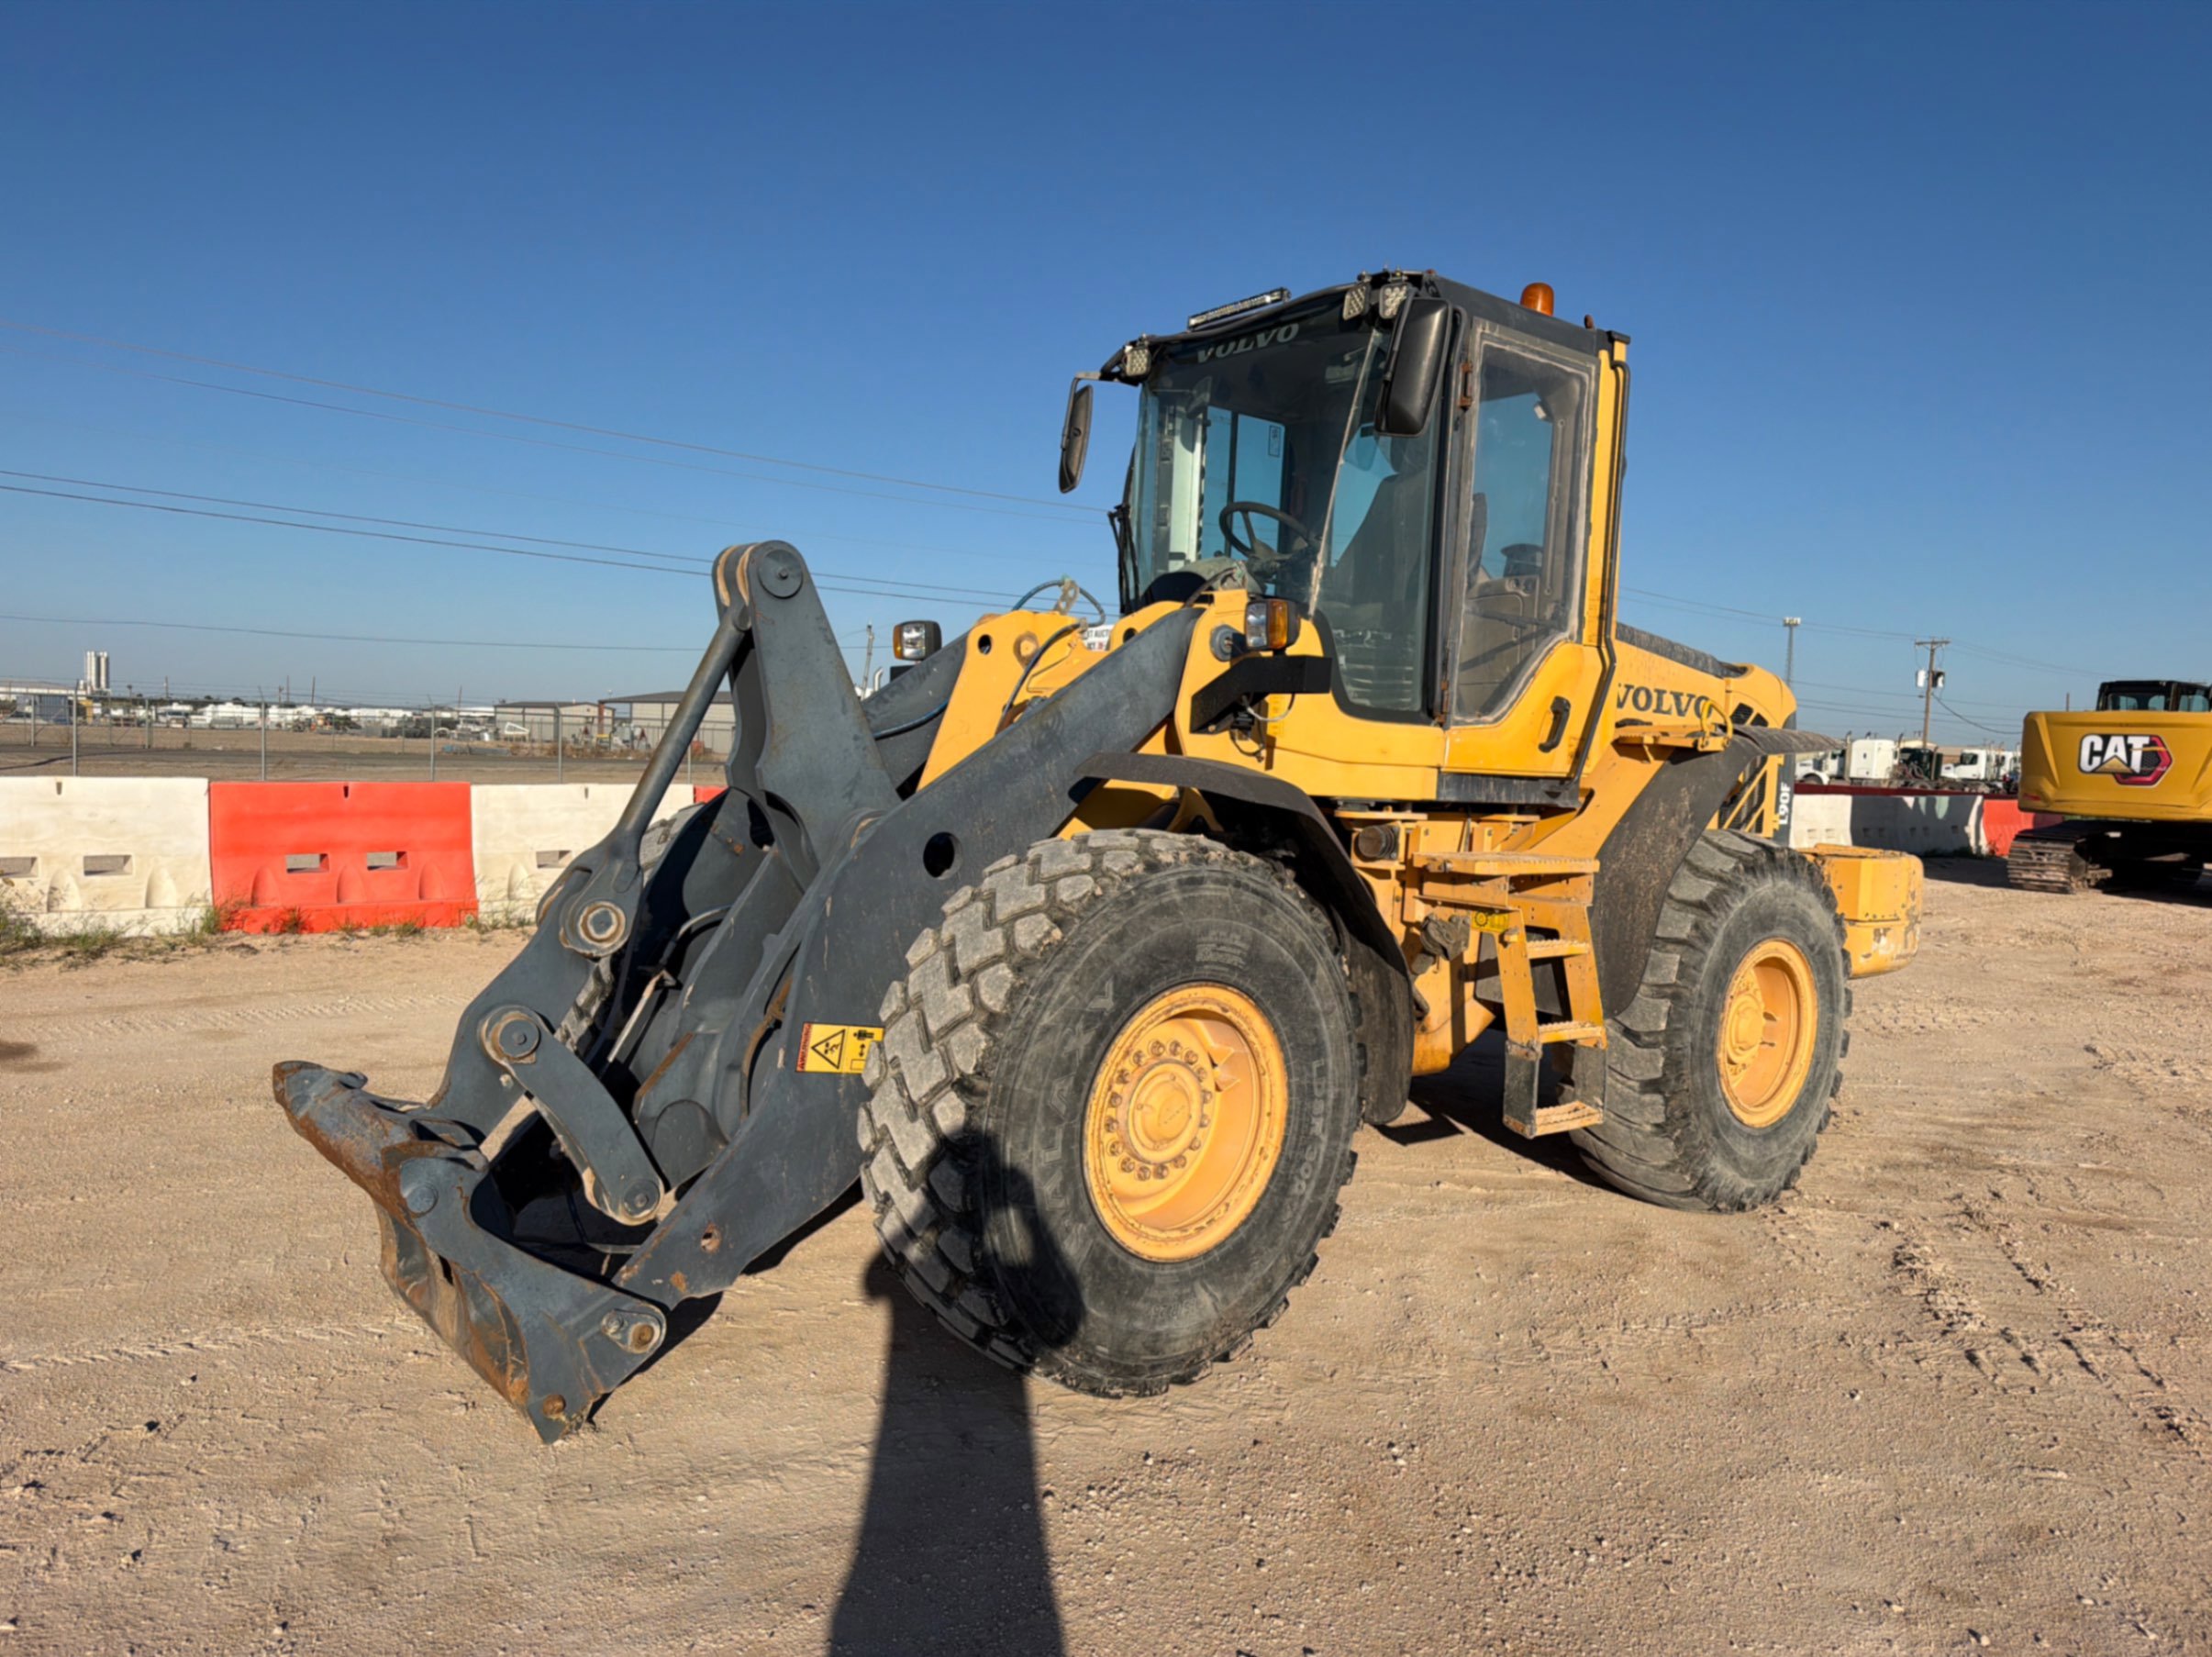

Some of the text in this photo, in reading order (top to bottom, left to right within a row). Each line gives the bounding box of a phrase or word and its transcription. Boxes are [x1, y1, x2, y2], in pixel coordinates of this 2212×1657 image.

[1197, 323, 1299, 363] VOLVO
[1617, 683, 1713, 720] VOLVO
[2080, 734, 2150, 774] CAT
[1779, 781, 1791, 825] L90F
